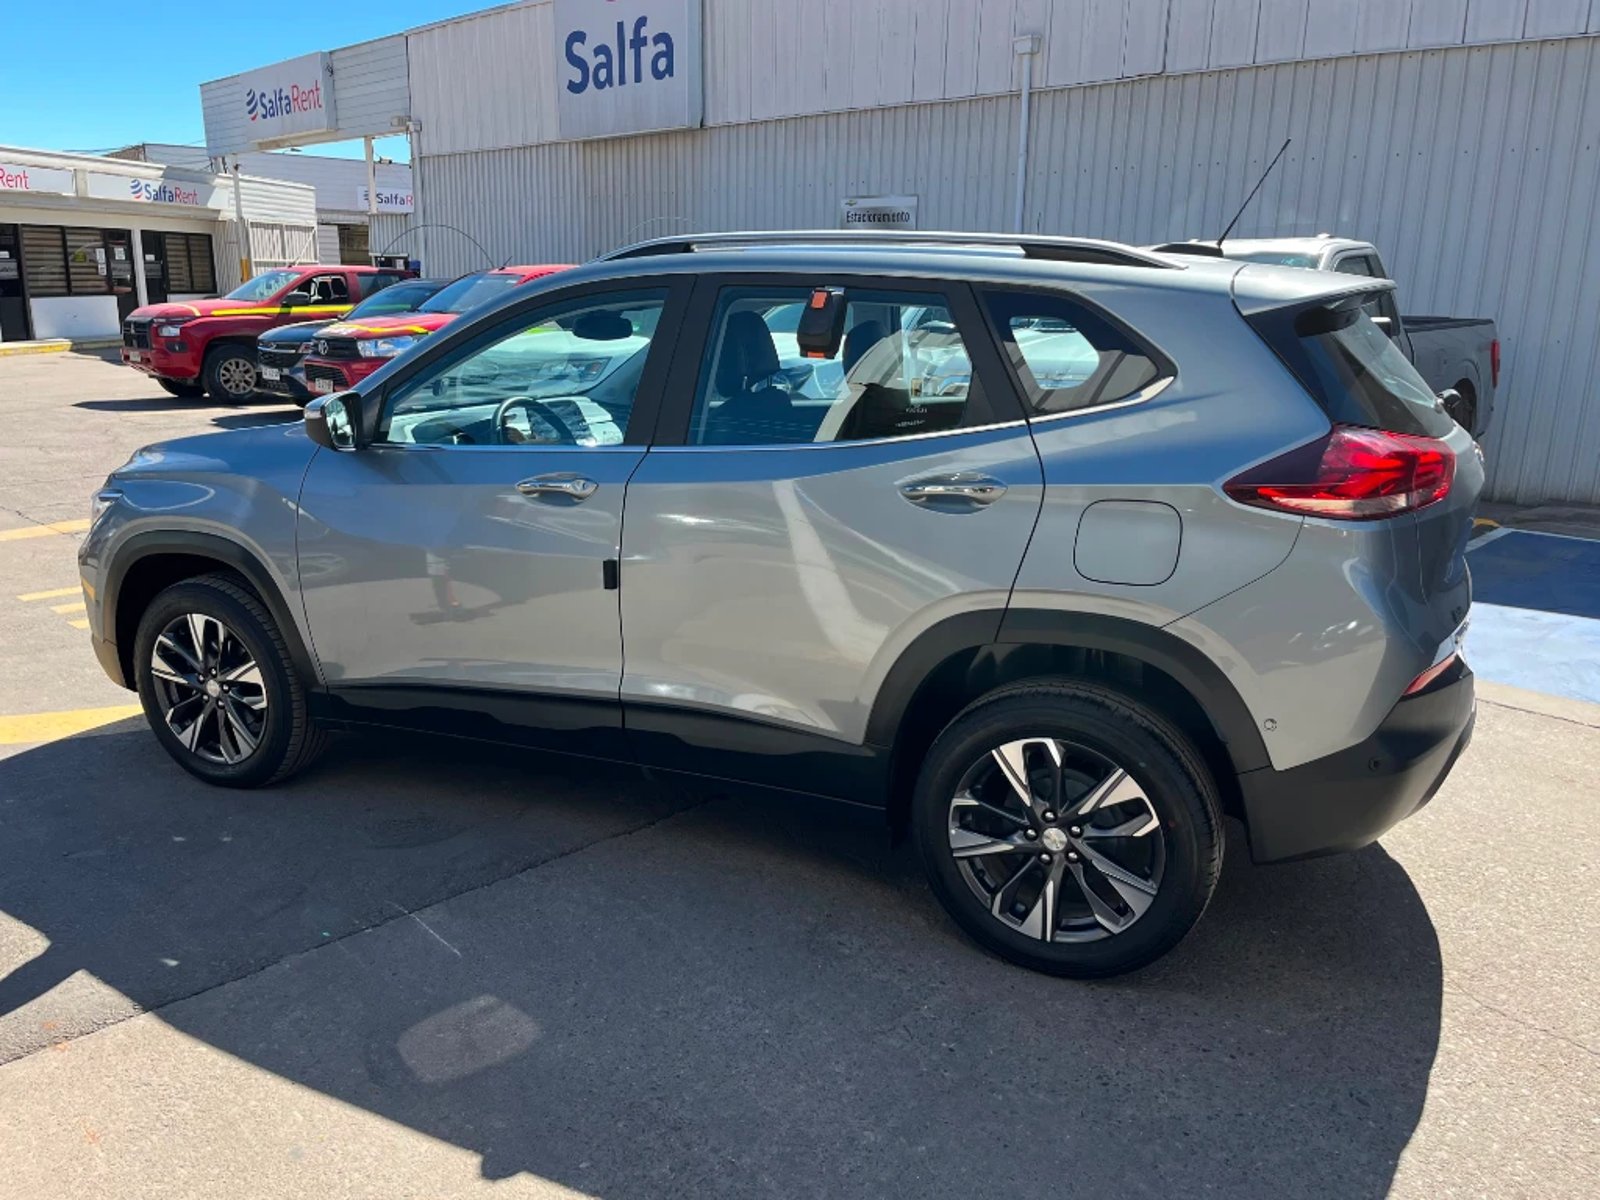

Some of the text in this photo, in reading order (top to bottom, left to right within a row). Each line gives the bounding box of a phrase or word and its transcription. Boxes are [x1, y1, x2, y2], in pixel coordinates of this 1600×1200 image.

[565, 15, 674, 94] Salfa
[259, 80, 322, 119] SalfaRent
[144, 184, 199, 205] SalfaRent
